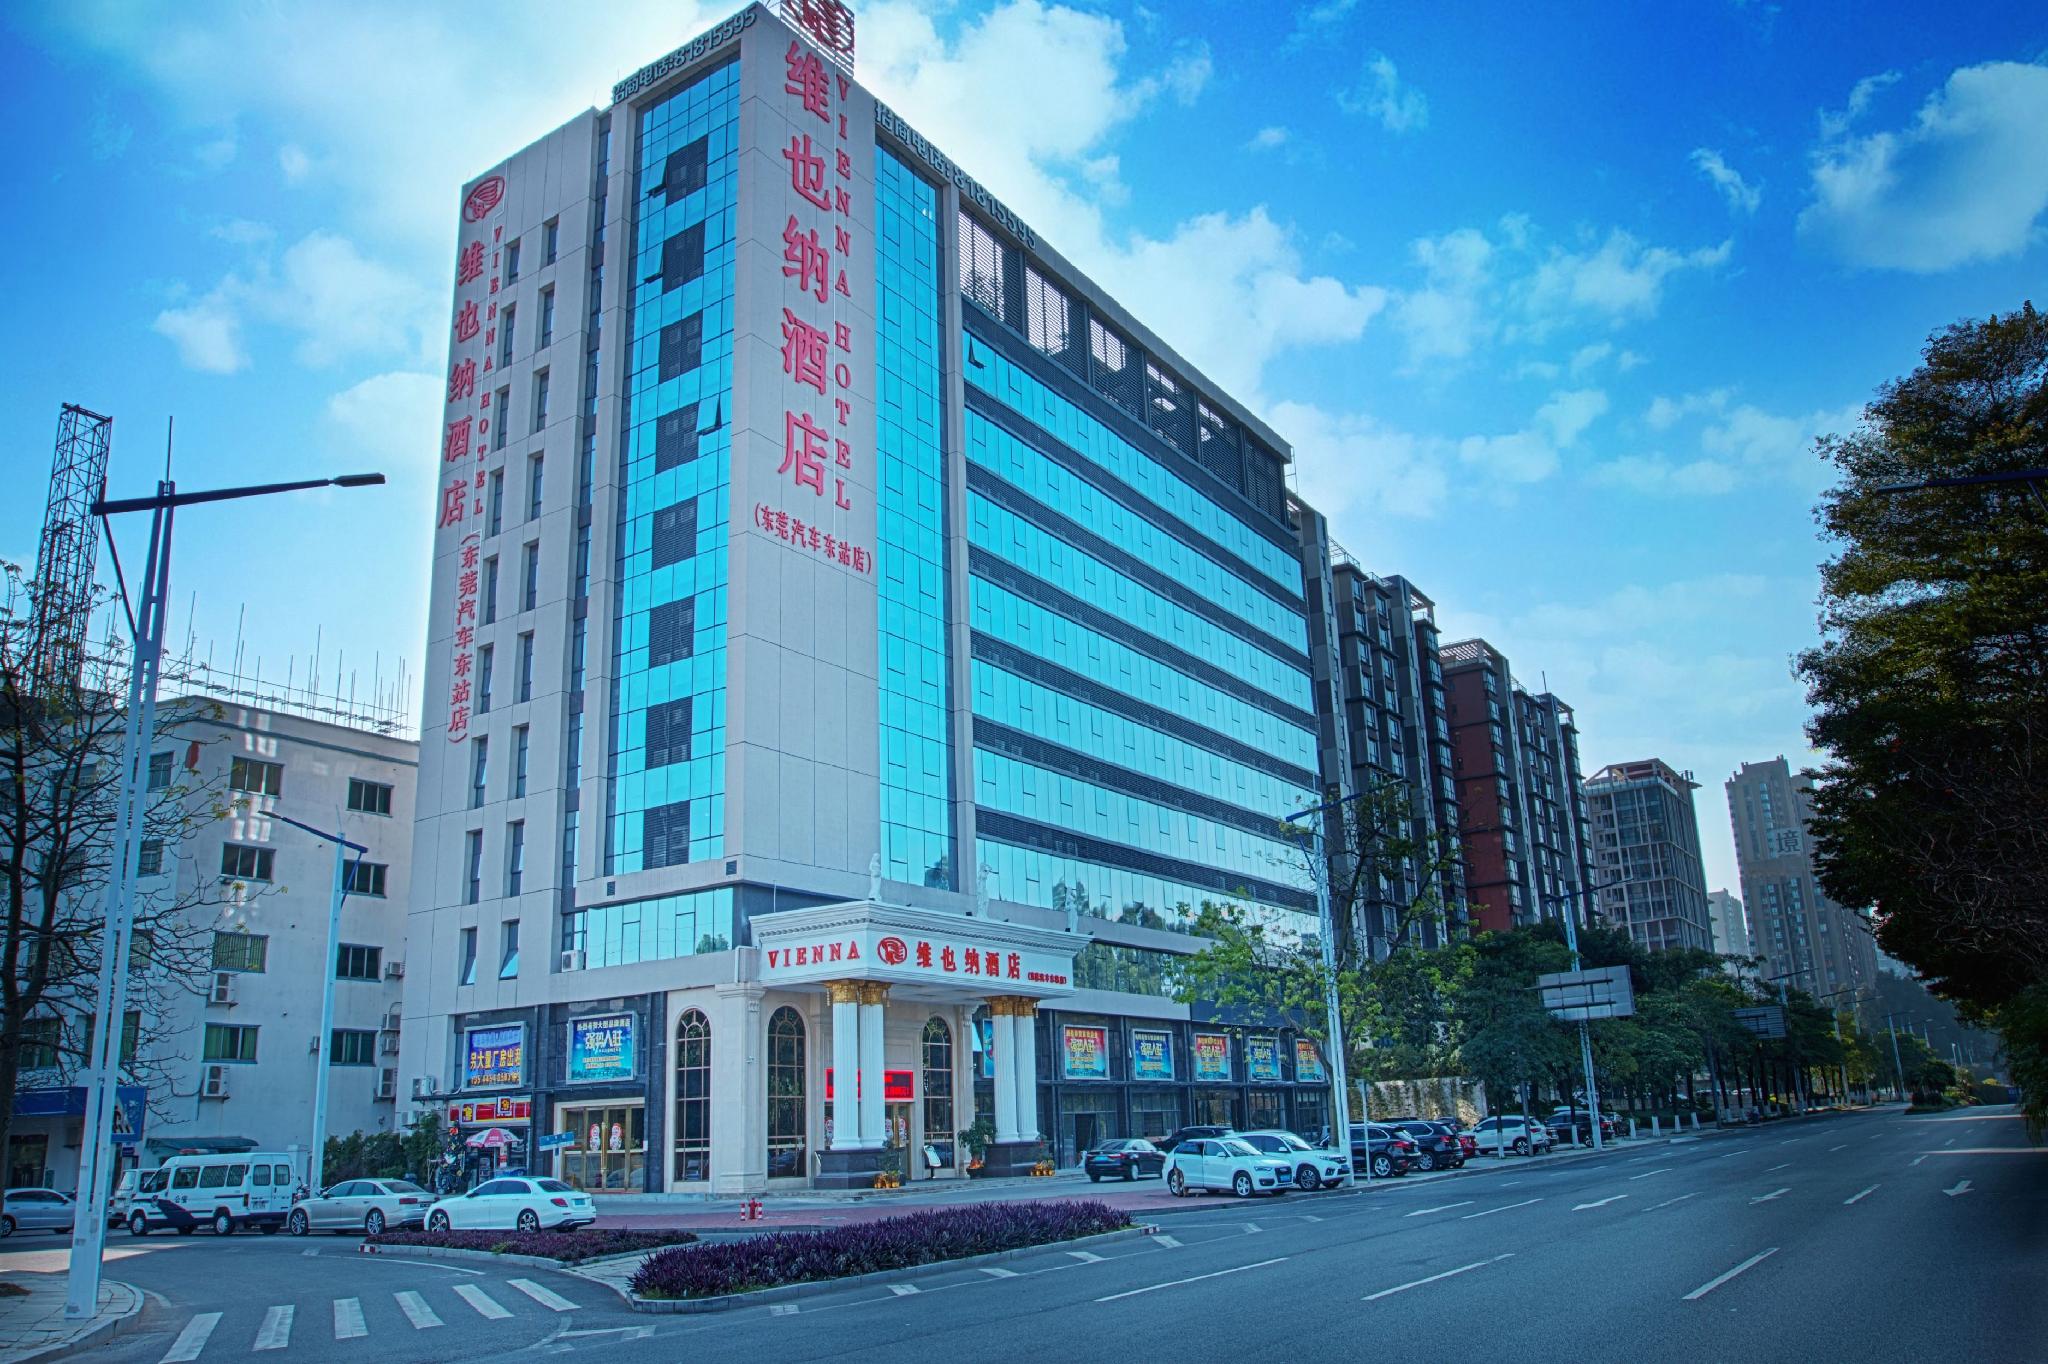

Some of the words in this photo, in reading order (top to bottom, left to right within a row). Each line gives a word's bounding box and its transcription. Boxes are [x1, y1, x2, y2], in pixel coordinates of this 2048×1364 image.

[834, 73, 852, 298] VIENNA
[483, 225, 503, 373] VIENNA
[778, 39, 832, 497] 维也纳酒店
[438, 240, 485, 530] 维也纳酒店
[472, 391, 491, 516] HOTEL
[834, 320, 852, 511] HOTEL
[754, 502, 872, 575] (东莞汽车东站店)
[447, 532, 481, 744] (东莞汽车东站店)
[1775, 829, 1801, 853] 境
[767, 940, 861, 970] VIENNA
[916, 940, 1021, 980] 维也纳酒店
